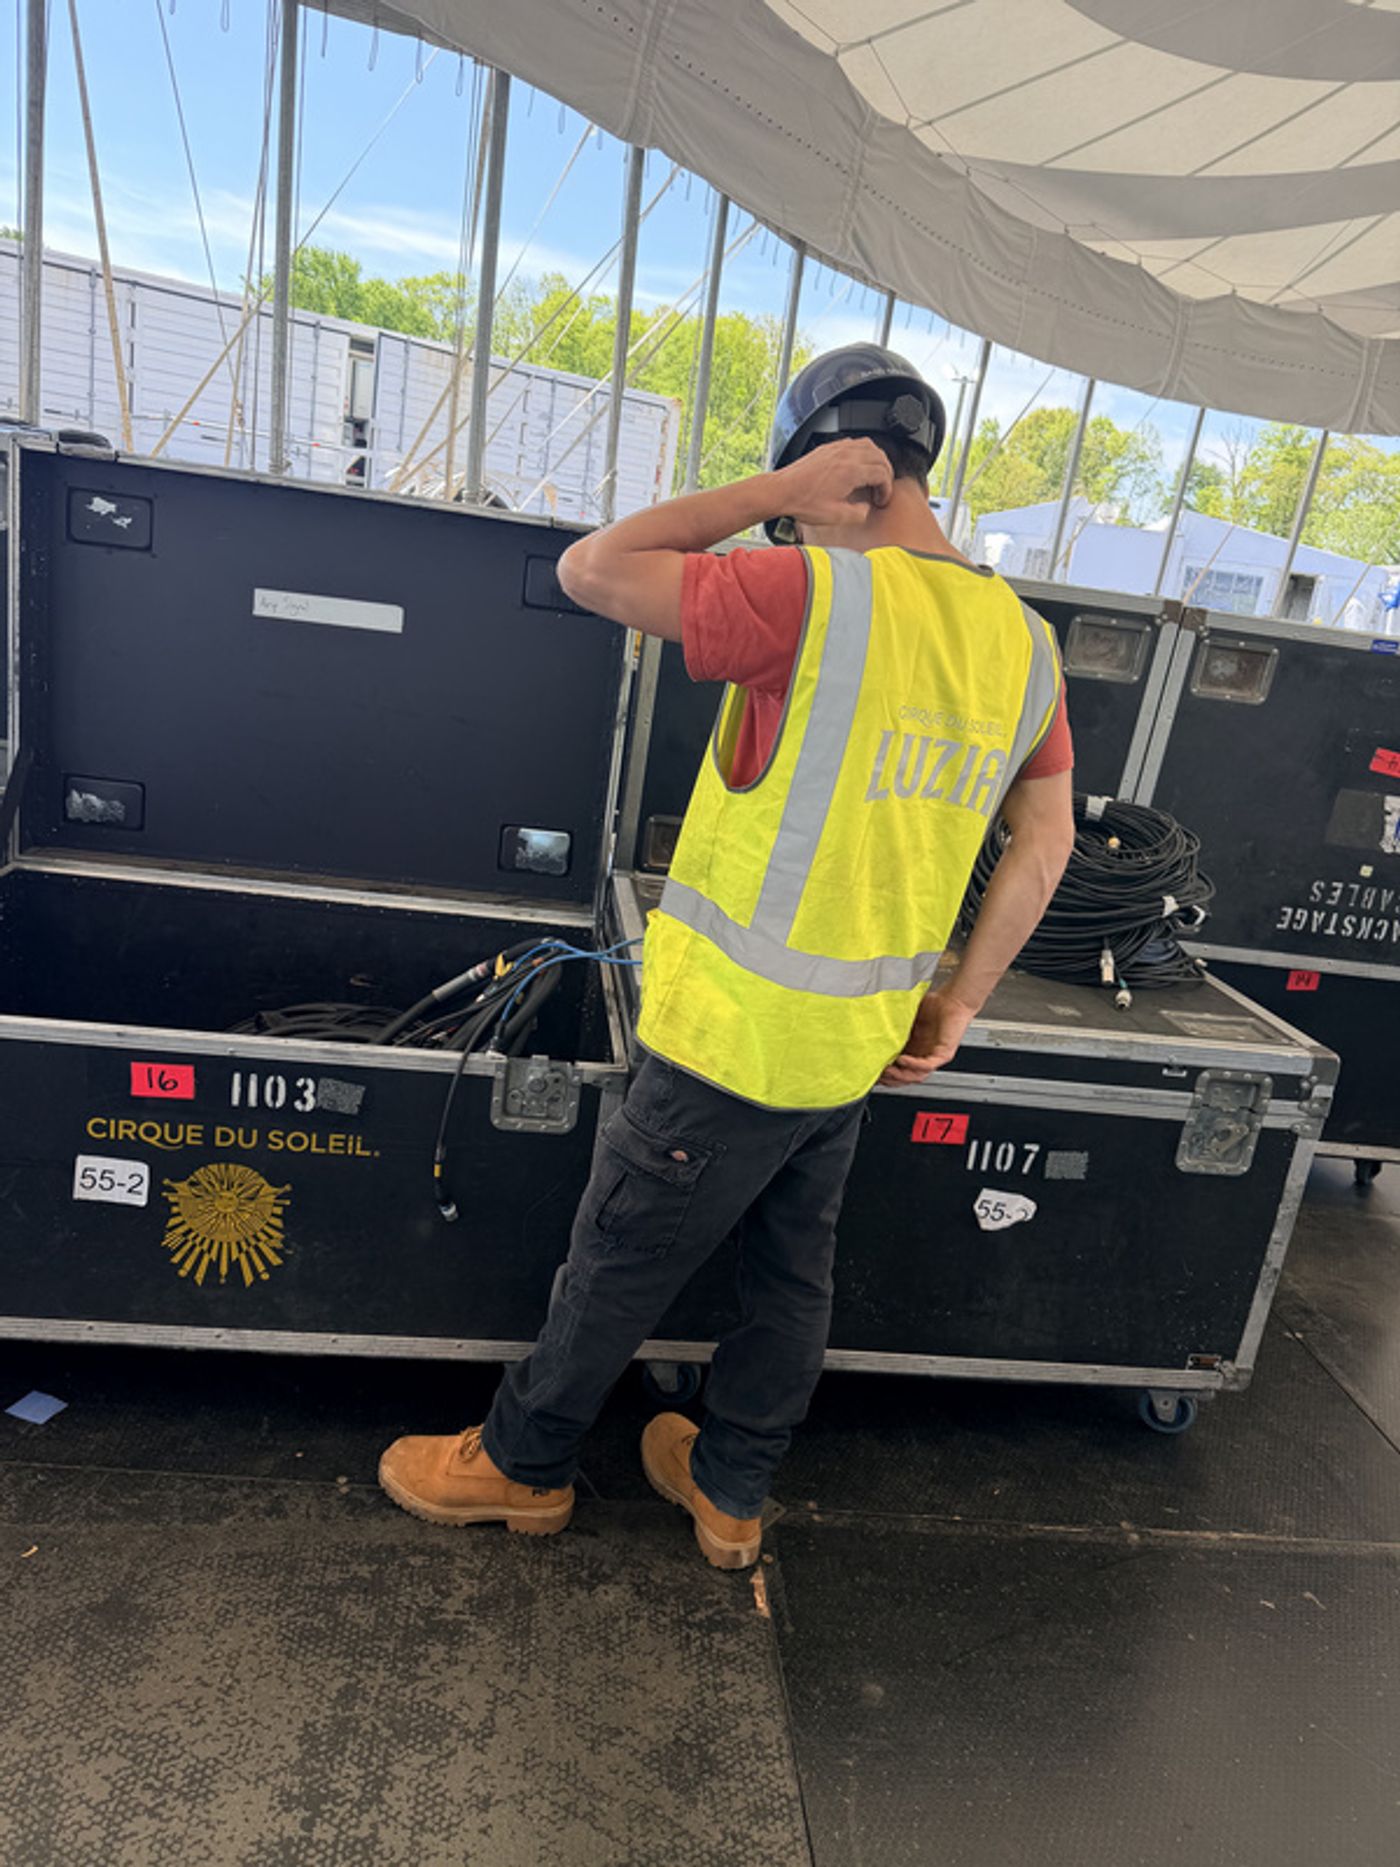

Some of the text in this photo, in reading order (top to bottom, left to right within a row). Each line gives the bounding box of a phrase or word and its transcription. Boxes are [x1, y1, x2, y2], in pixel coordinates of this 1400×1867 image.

[898, 705, 943, 729] CIRQUE
[864, 730, 1008, 817] LUZIA
[146, 1066, 179, 1093] 16
[230, 1071, 317, 1113] 1103
[86, 1116, 204, 1151] CIRQUE
[214, 1125, 259, 1149] DU
[921, 1117, 955, 1141] 17
[966, 1139, 1040, 1175] 1107
[79, 1166, 145, 1196] 55-2
